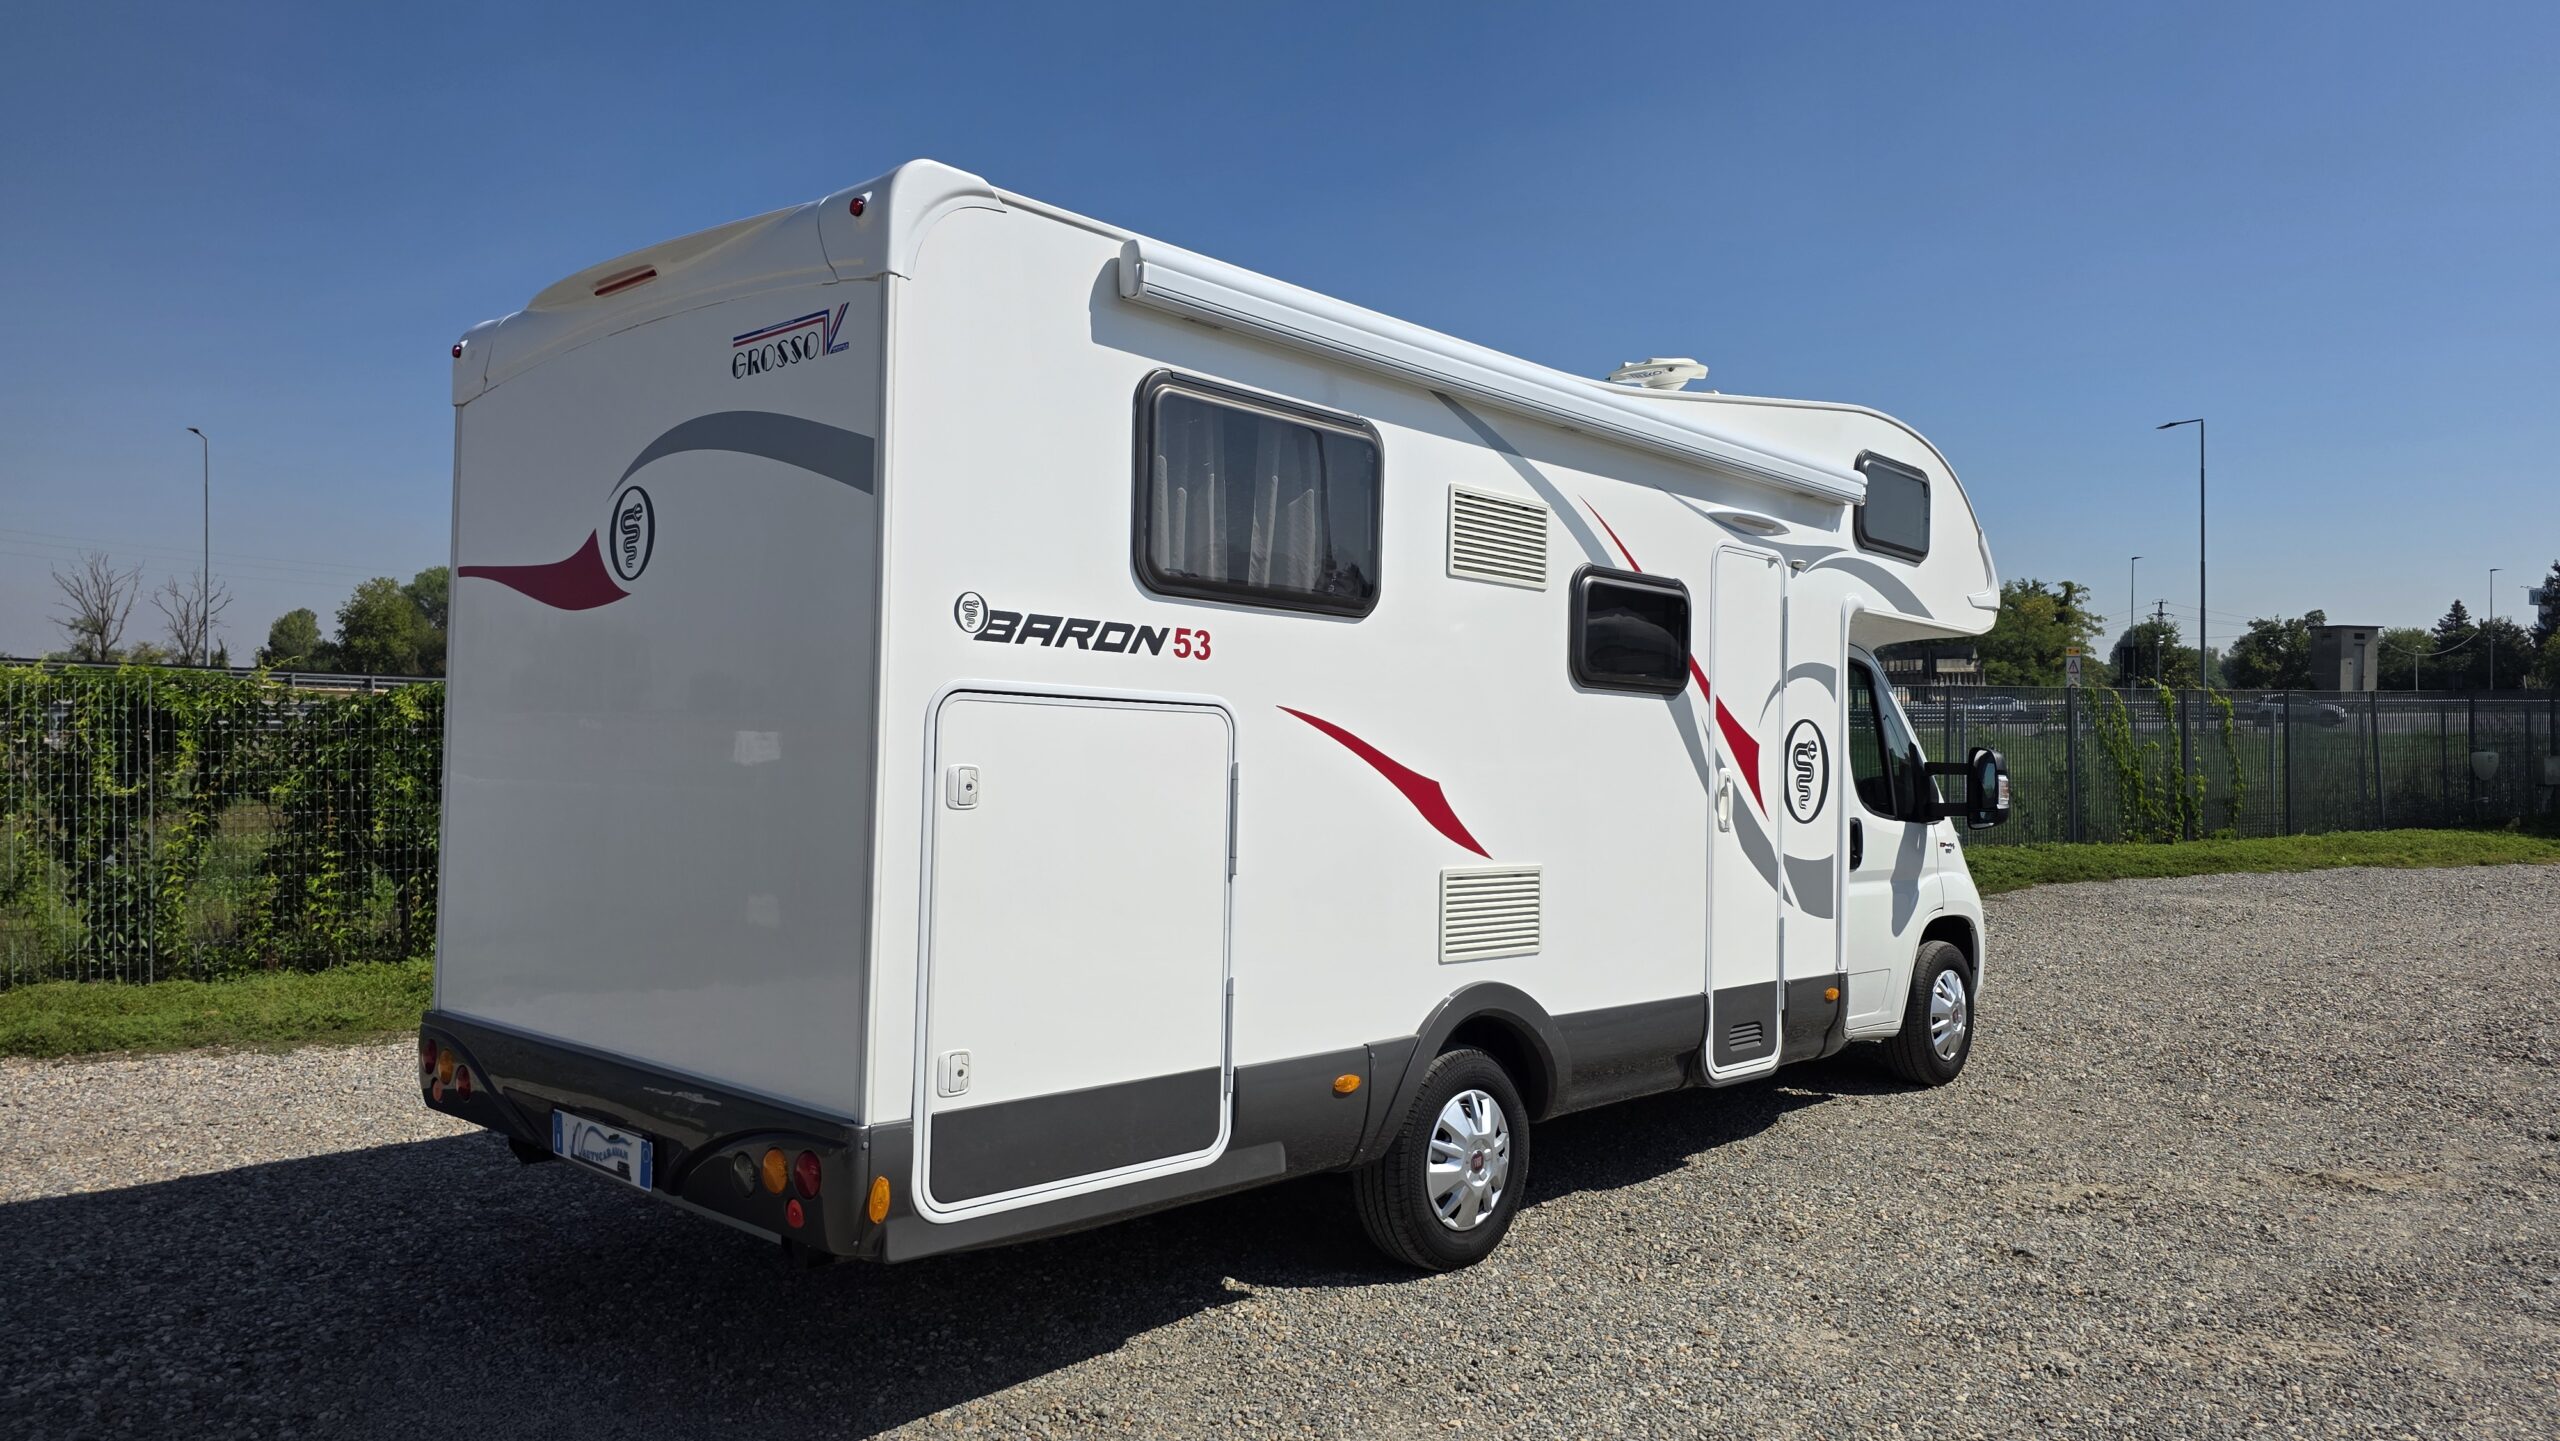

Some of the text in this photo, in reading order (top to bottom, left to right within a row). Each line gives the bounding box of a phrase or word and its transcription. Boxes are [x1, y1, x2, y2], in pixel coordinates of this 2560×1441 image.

[732, 331, 820, 380] GROSSO
[973, 609, 1212, 660] BARON 53
